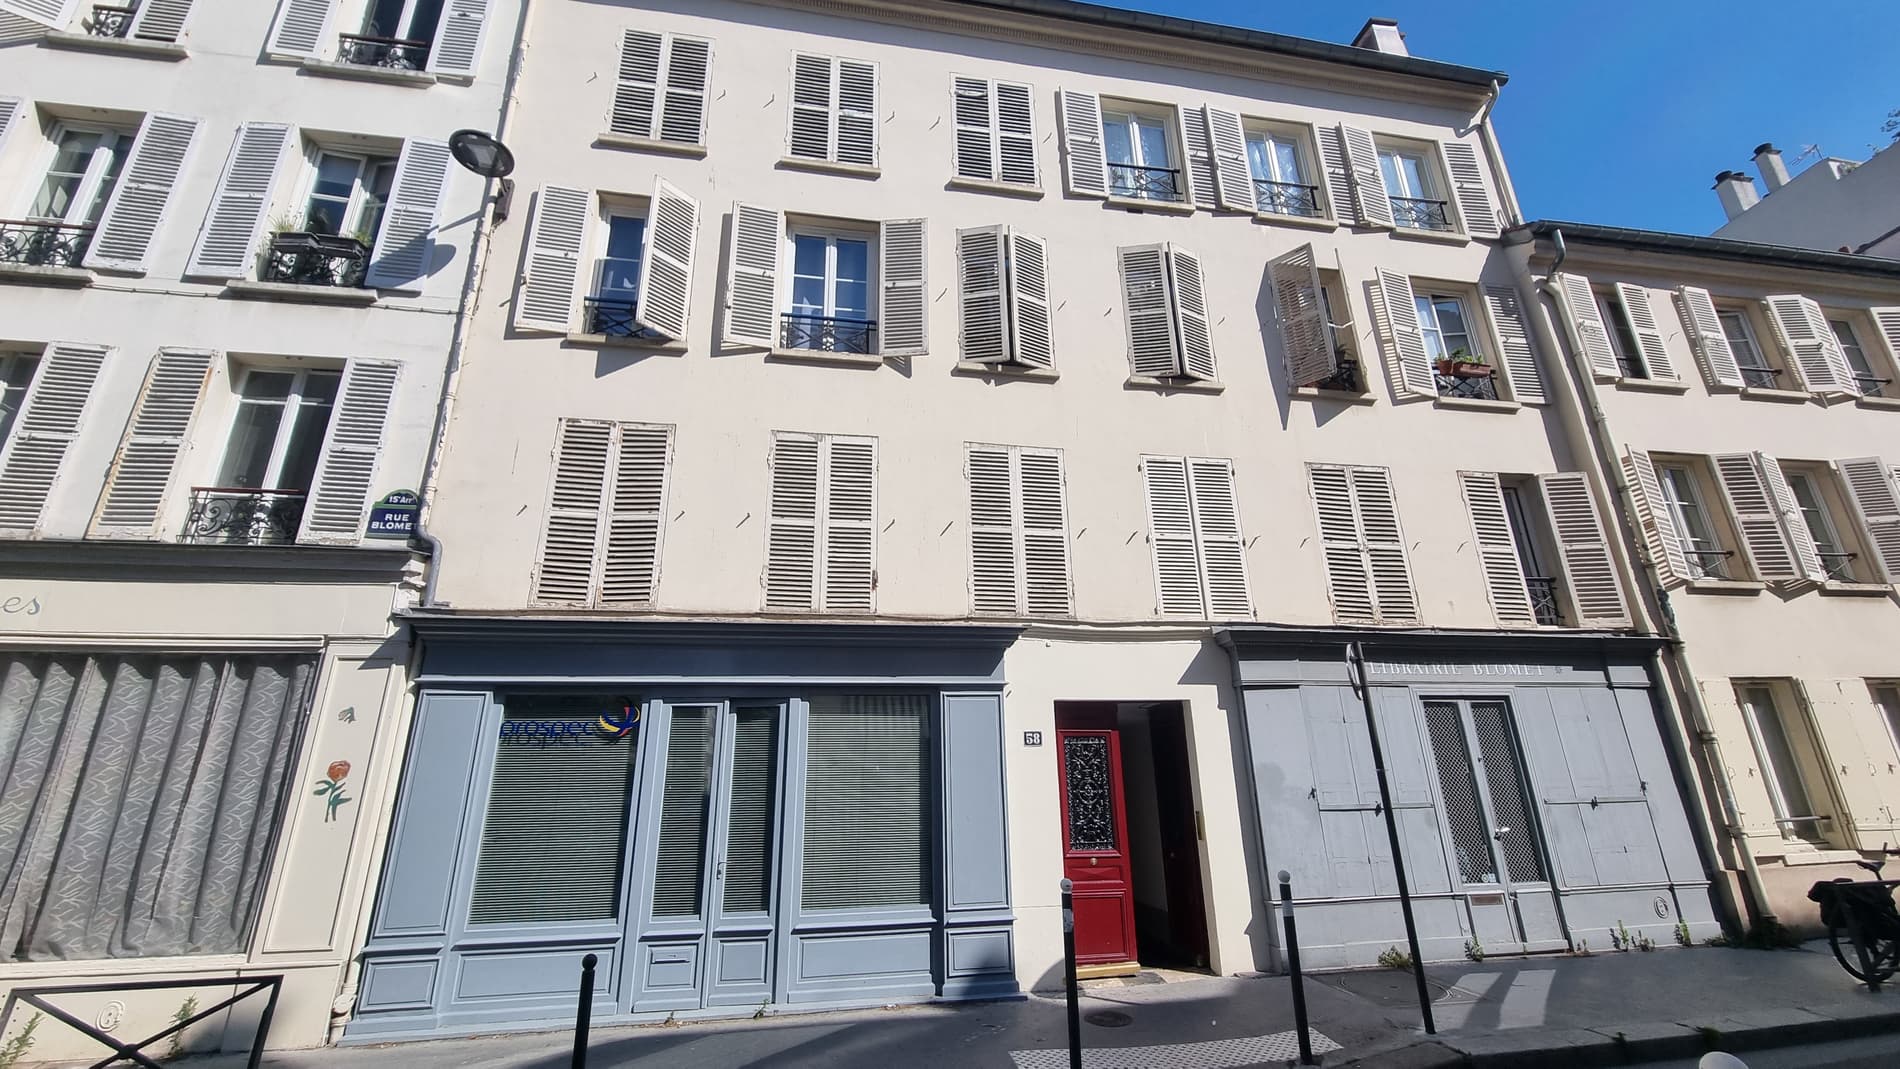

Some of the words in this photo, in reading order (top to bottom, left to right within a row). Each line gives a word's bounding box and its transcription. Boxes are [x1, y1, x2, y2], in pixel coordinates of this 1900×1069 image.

[385, 513, 410, 522] RUE
[0, 596, 41, 616] es
[1370, 661, 1462, 675] LIBRAIRIE
[1471, 663, 1545, 676] BLOMET
[1025, 733, 1041, 745] 58
